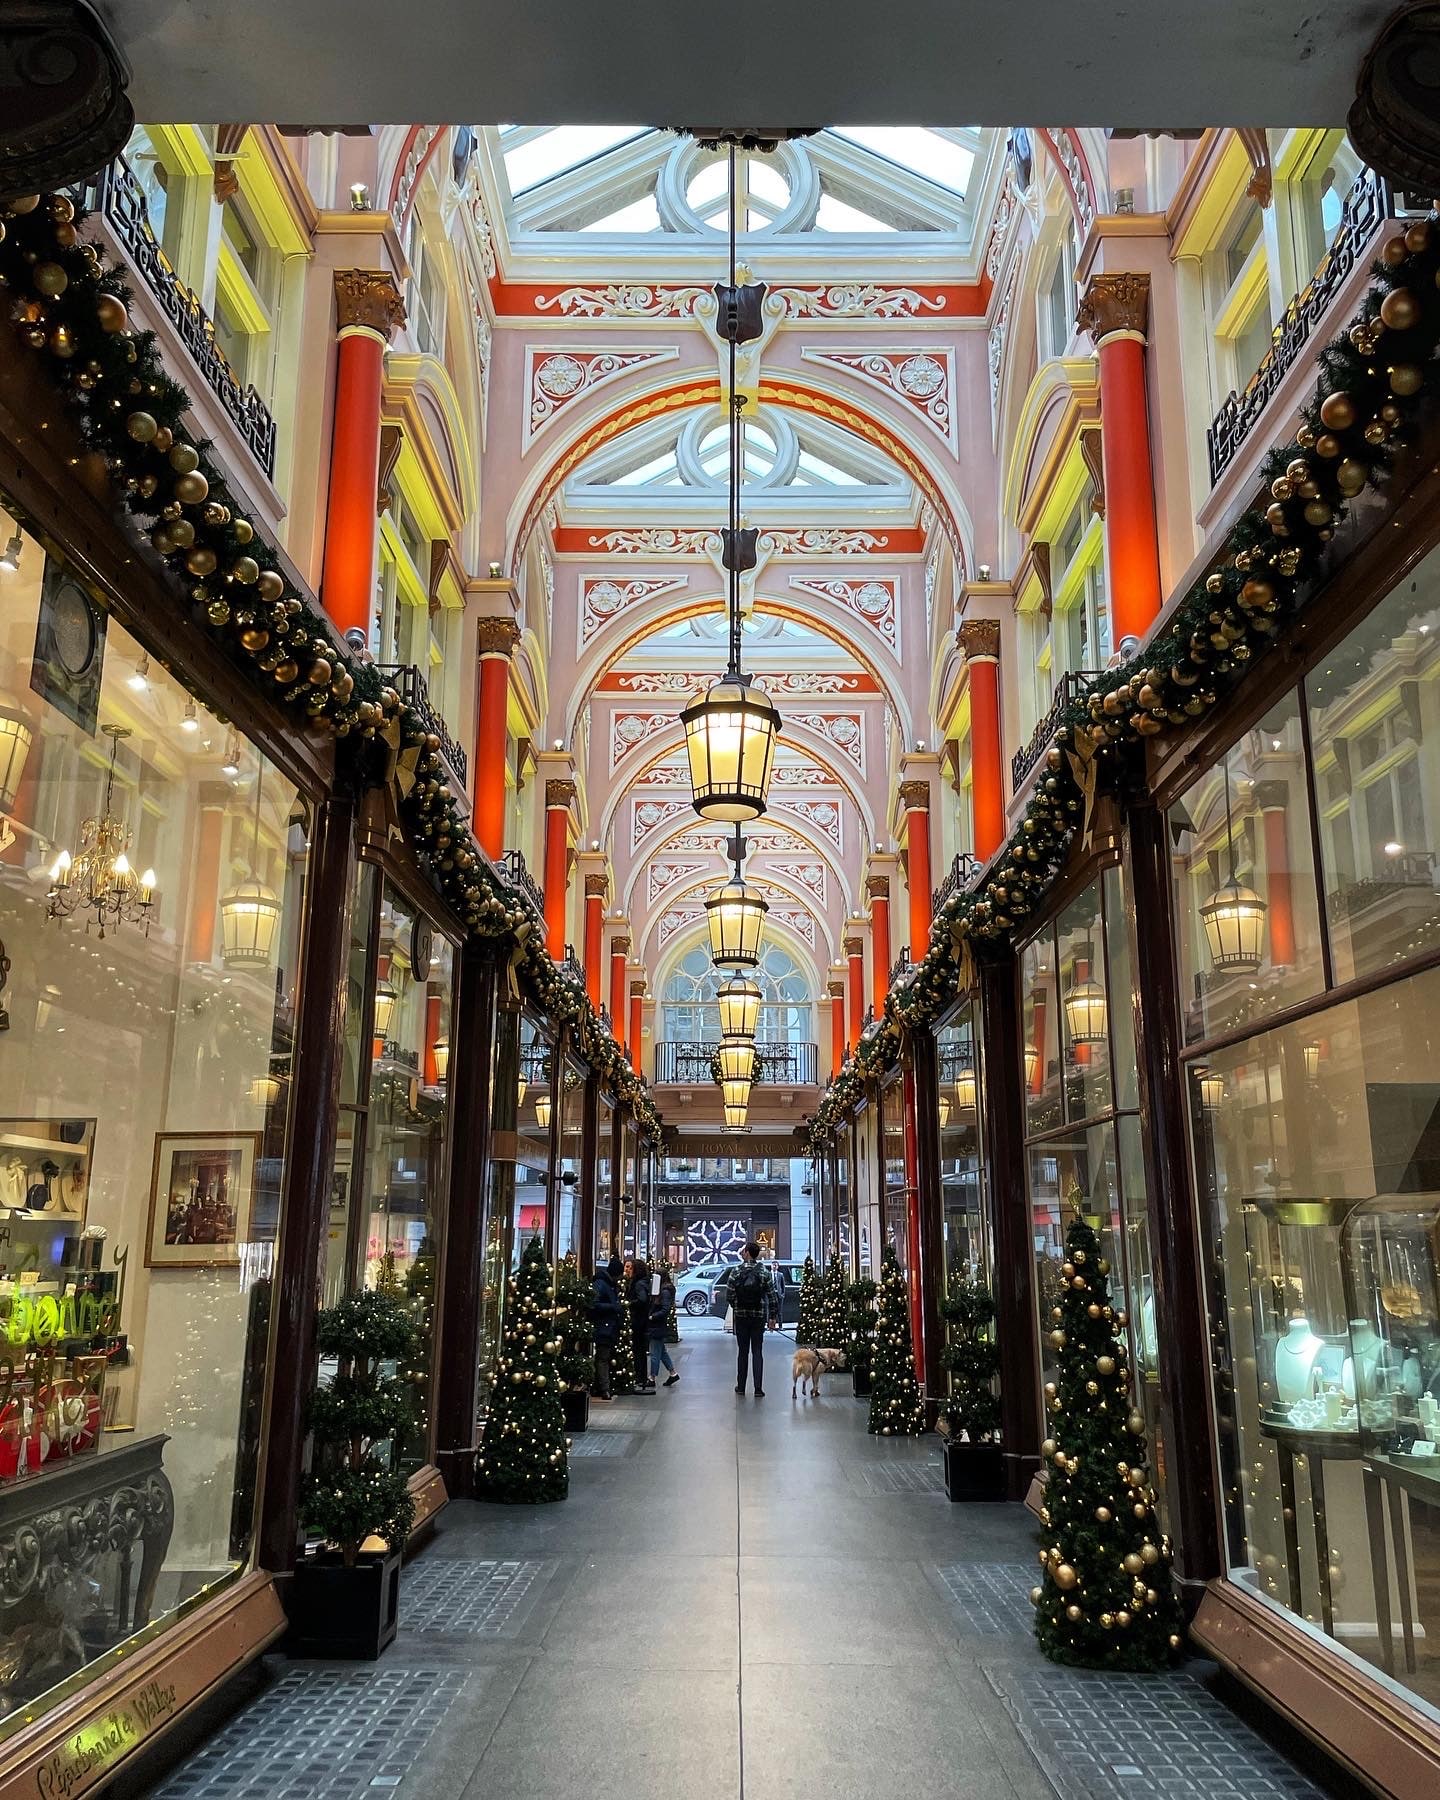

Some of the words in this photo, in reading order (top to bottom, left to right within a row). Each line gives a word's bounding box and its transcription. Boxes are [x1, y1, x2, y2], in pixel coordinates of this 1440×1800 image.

[670, 1143, 691, 1154] THE
[700, 1143, 742, 1154] ROYAL
[658, 1195, 710, 1206] BUCCELLATI
[37, 1712, 125, 1800] Charbonnel
